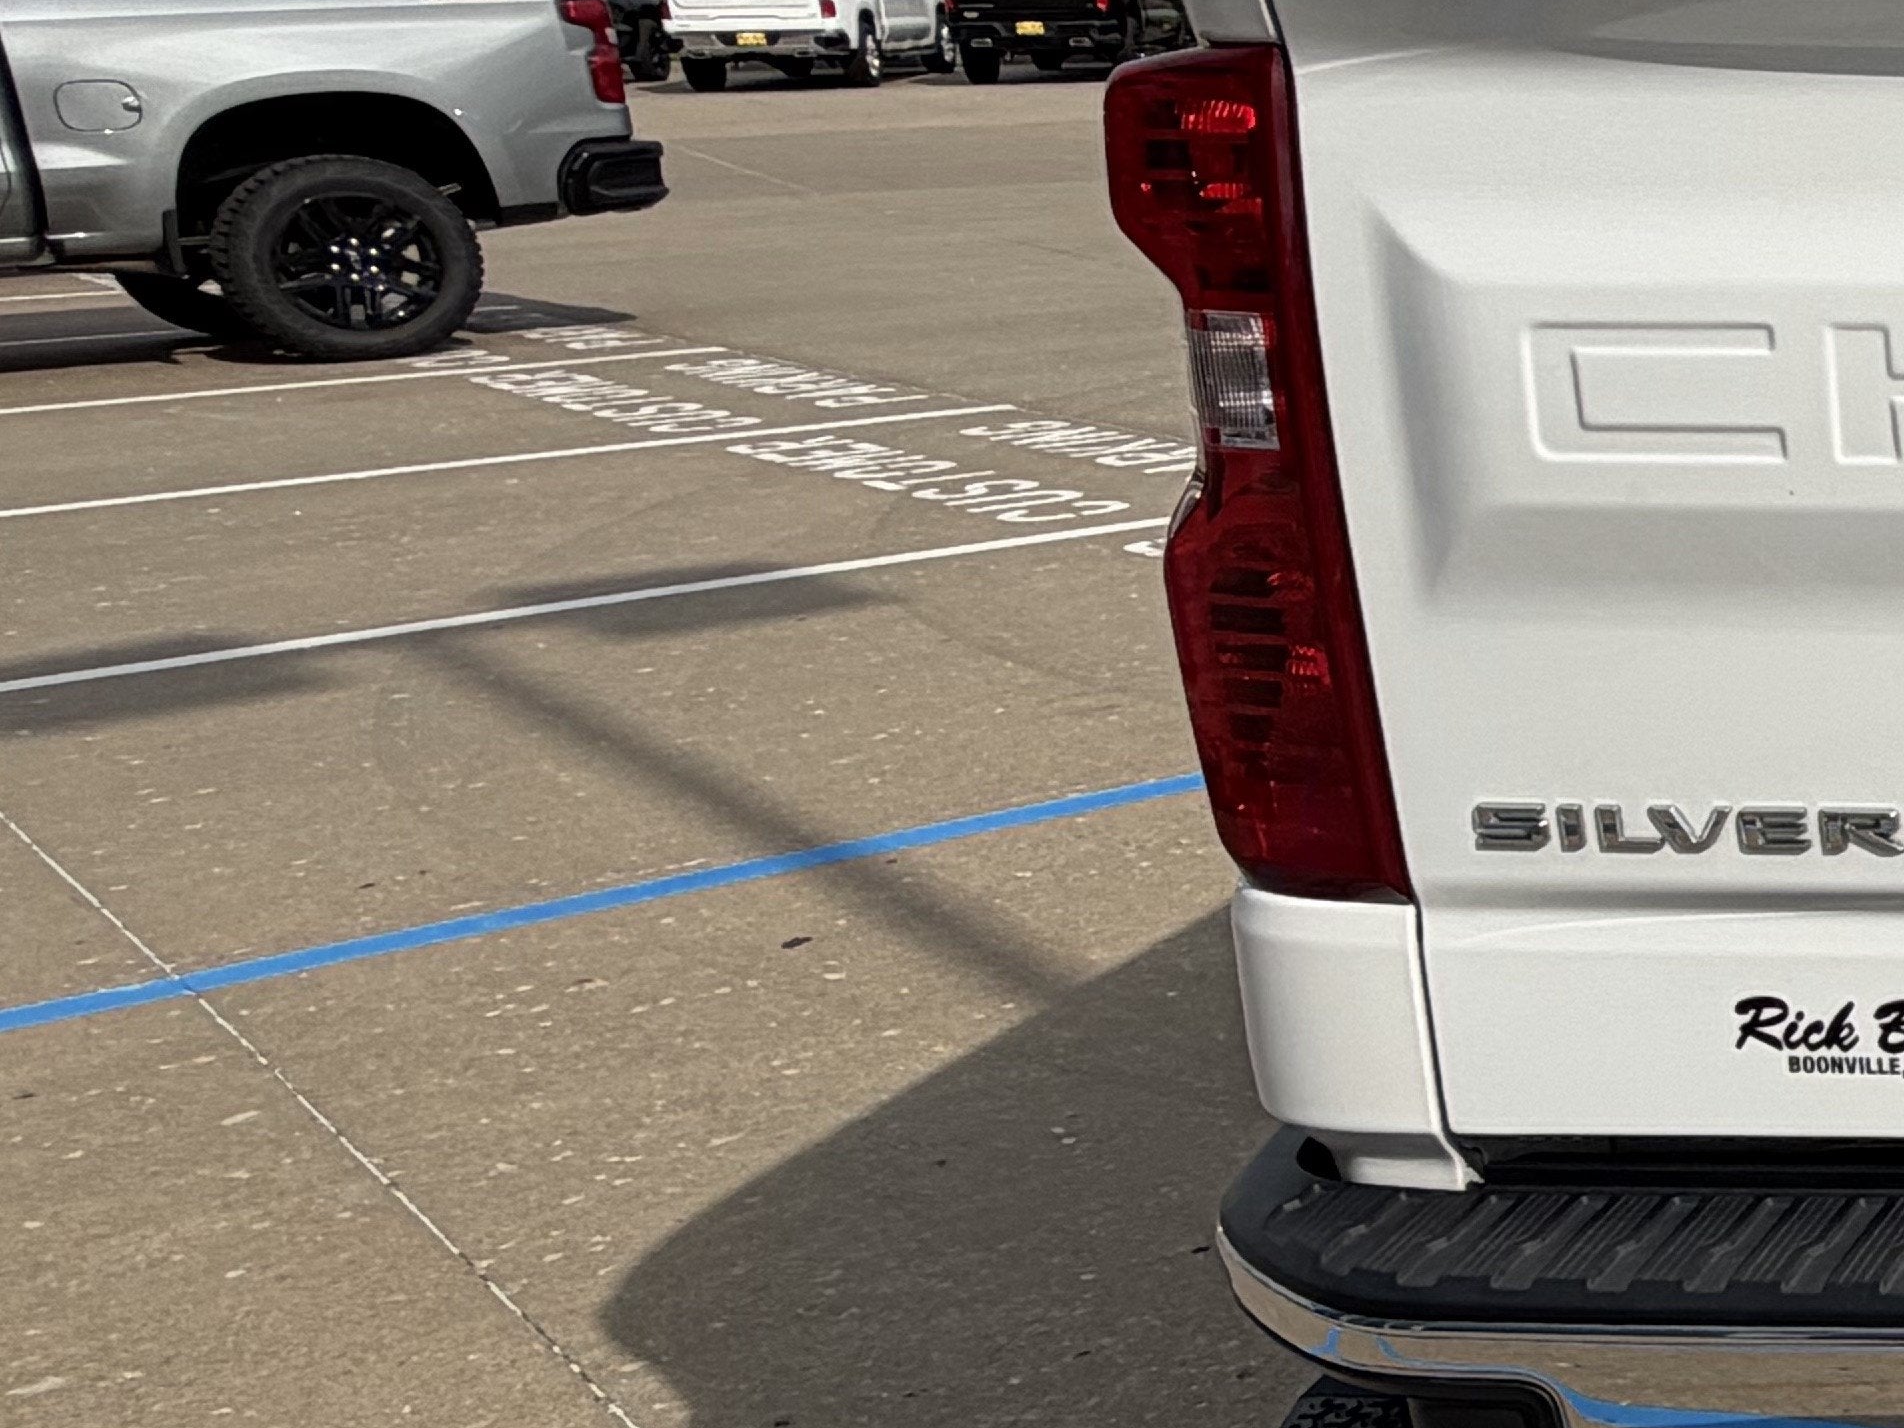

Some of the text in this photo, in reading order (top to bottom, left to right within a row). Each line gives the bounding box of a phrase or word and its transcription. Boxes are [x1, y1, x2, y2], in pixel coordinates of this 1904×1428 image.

[469, 370, 762, 432] CUSTOMER
[664, 359, 929, 408] PARKING
[959, 420, 1197, 473] ARKING
[726, 435, 1130, 522] CUSTOMER
[1734, 996, 1859, 1052] Rick
